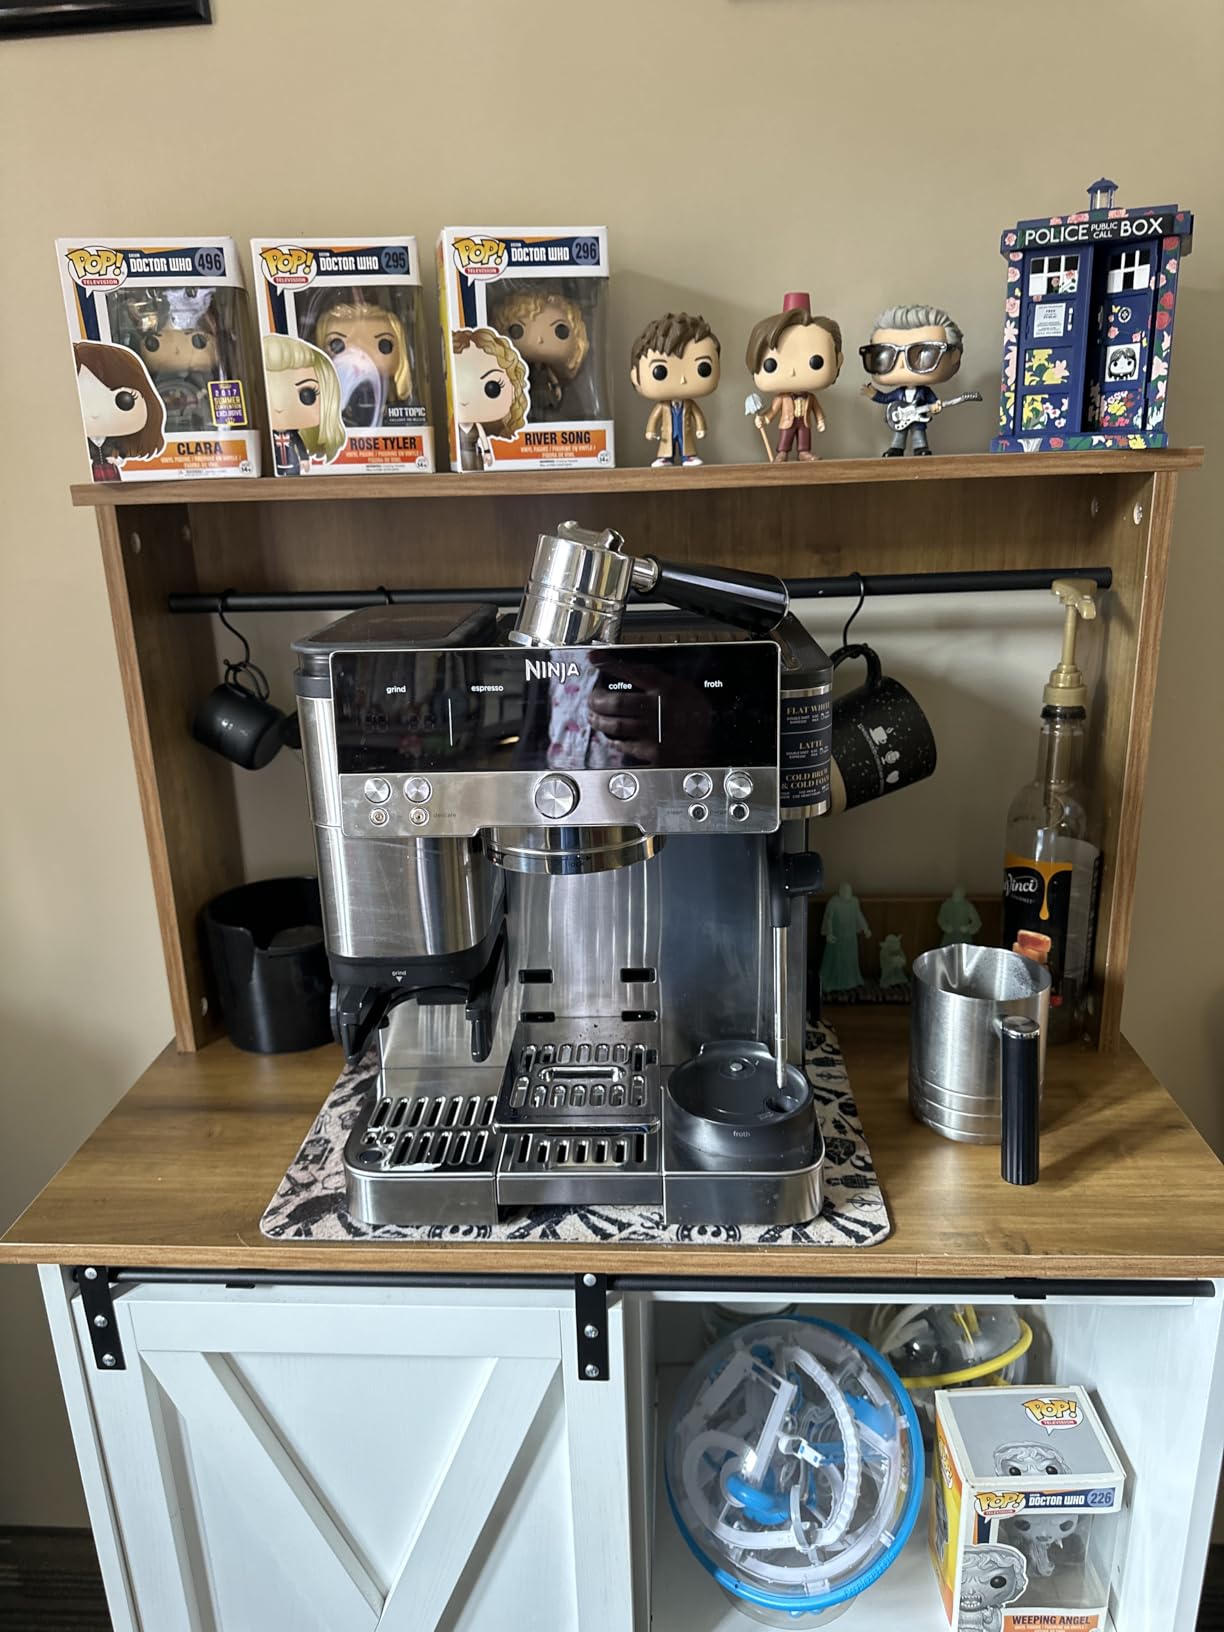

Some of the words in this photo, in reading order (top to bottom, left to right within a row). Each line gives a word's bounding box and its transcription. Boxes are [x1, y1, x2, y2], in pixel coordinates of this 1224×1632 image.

[1091, 222, 1118, 232] PUBLIC
[1093, 230, 1112, 239] CALL
[1120, 217, 1163, 237] BOX
[1025, 224, 1089, 246] POLICE
[452, 237, 506, 267] POP!
[511, 247, 546, 262] DOCTOR
[547, 246, 569, 261] WHO
[575, 242, 597, 260] 296
[65, 249, 124, 279] POP!
[130, 257, 168, 273] DOCTOR
[168, 256, 193, 272] WHO
[197, 252, 222, 271] 496
[259, 247, 314, 277] POP!
[319, 256, 356, 272] DOCTOR
[356, 255, 379, 271] WHO
[384, 251, 406, 270] 295
[214, 389, 237, 397] 2017
[388, 407, 404, 417] HOT
[404, 407, 426, 417] TOPIC
[350, 436, 380, 451] ROSE
[382, 436, 417, 450] TYLER
[525, 432, 558, 446] RIVER
[561, 431, 591, 445] SONG
[176, 442, 223, 456] CLARA
[525, 659, 580, 683] NINJA
[386, 685, 407, 694] grind
[471, 684, 504, 693] espresso
[608, 682, 633, 690] coffee
[704, 680, 723, 688] froth
[733, 1130, 751, 1138] froth
[1021, 1399, 1078, 1421] POP!
[974, 1492, 1025, 1511] POP!
[1028, 1495, 1063, 1506] DOCTOR
[1063, 1495, 1085, 1505] WHO
[1090, 1492, 1112, 1505] 226
[1012, 1615, 1057, 1625] WEEPING
[1058, 1615, 1091, 1625] ANGEL
